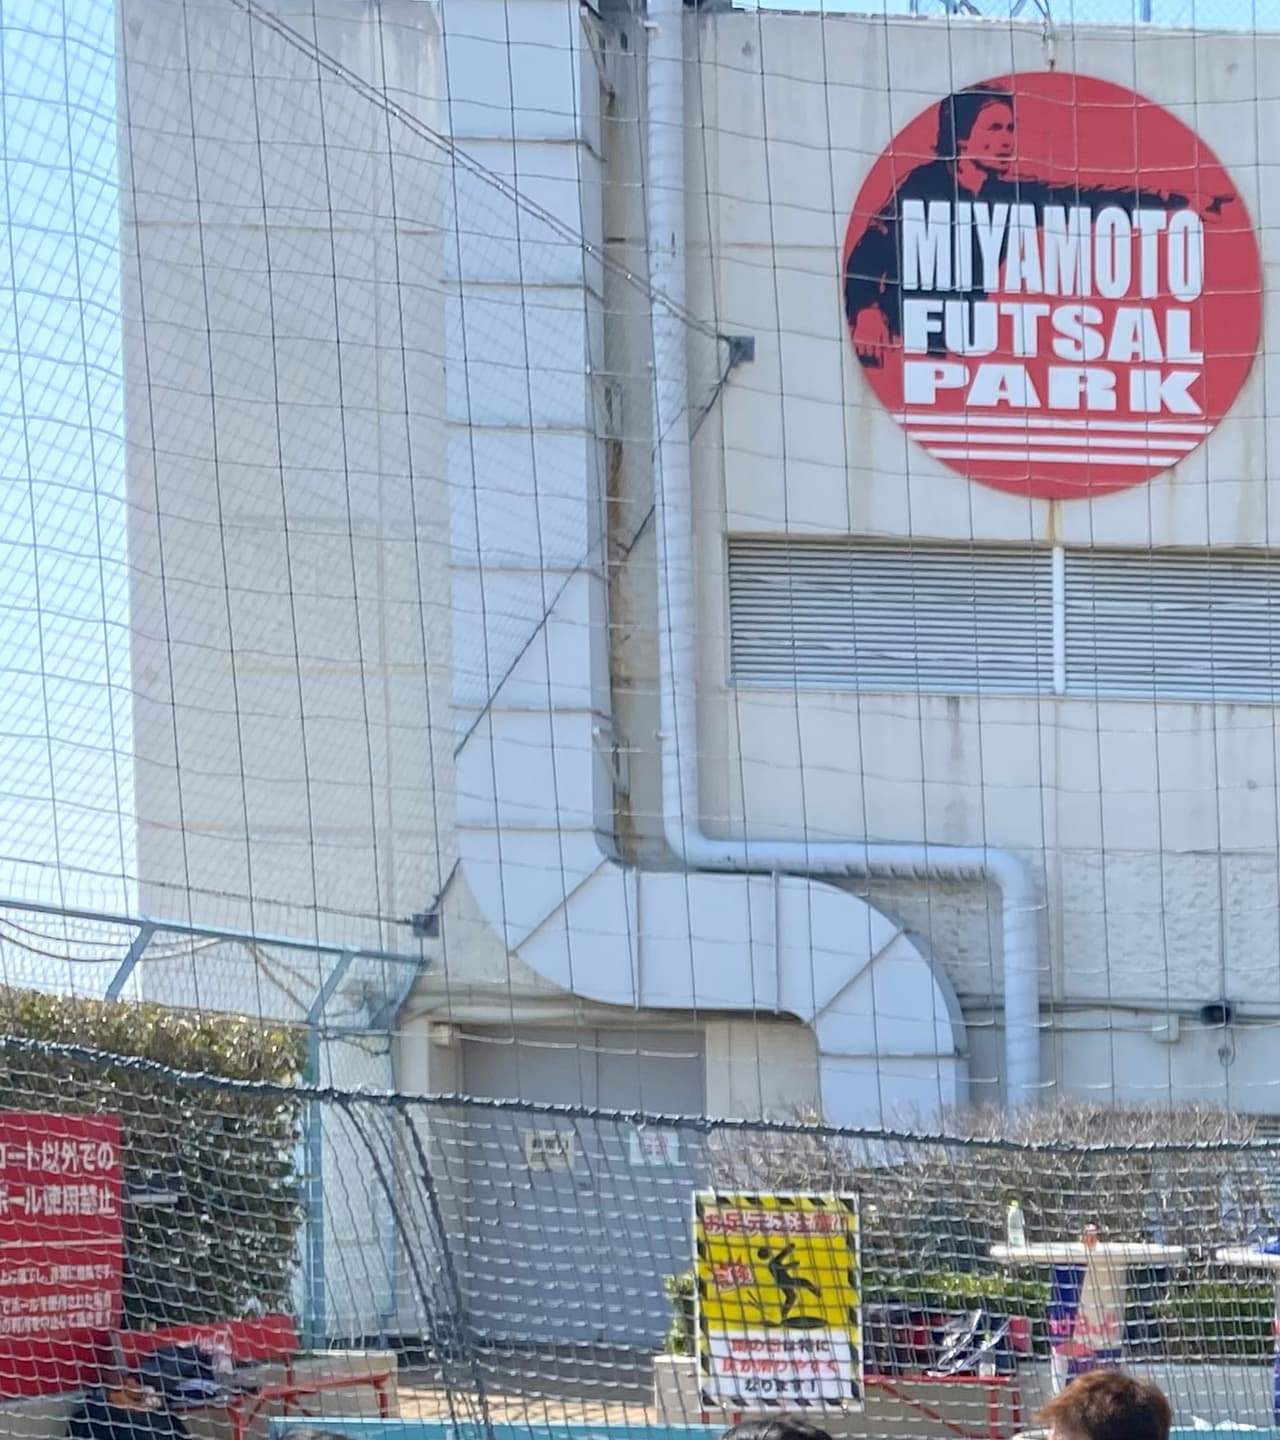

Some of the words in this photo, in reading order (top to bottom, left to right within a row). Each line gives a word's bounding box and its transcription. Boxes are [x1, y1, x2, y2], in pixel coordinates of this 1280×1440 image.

[902, 200, 1204, 301] MIYAMOTO
[903, 299, 1204, 364] FUTSAL
[904, 361, 1202, 414] PARK
